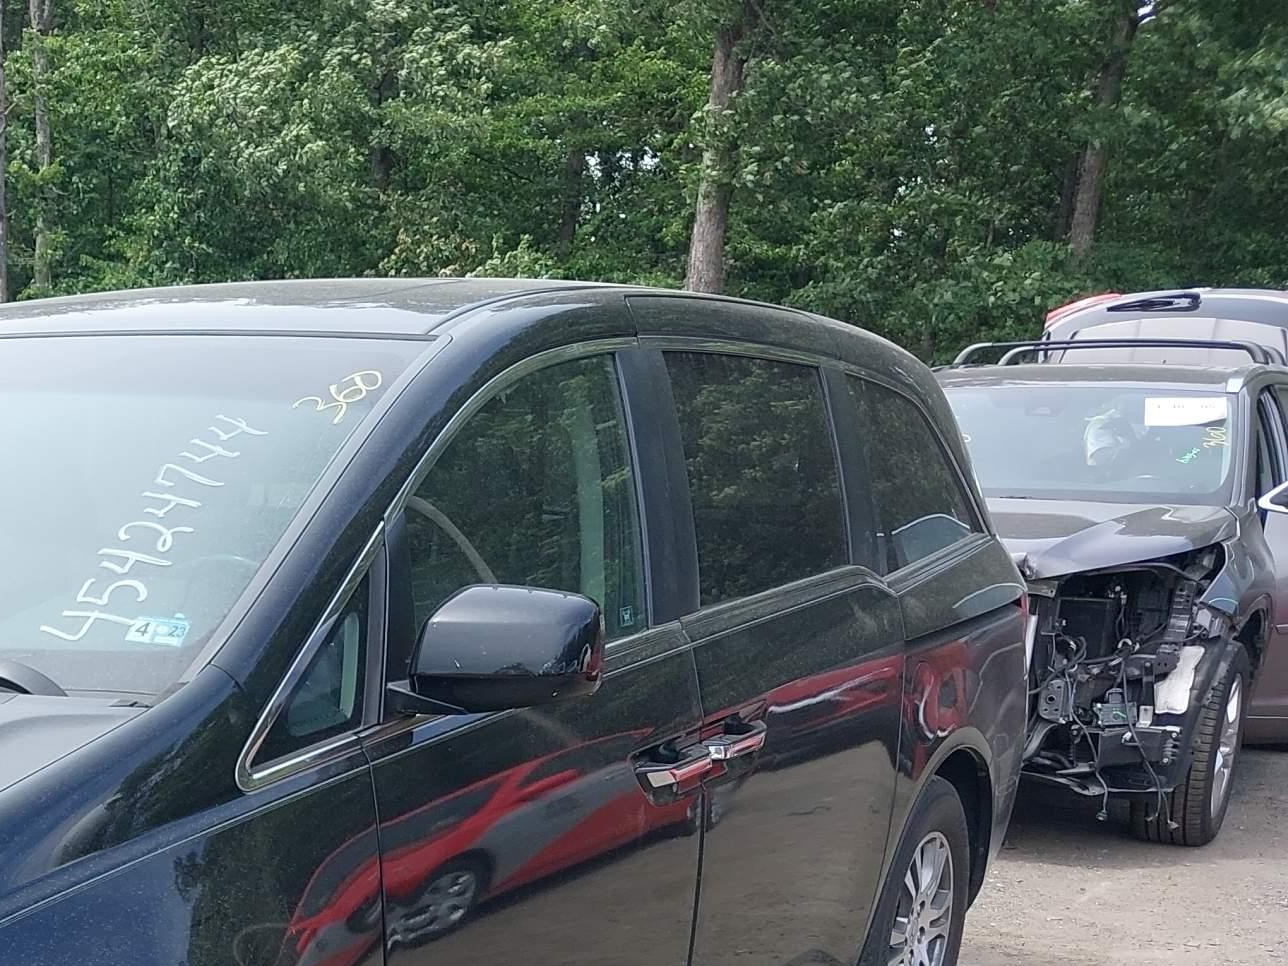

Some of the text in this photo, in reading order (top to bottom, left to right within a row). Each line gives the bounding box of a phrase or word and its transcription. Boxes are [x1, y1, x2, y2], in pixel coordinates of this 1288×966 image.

[292, 370, 382, 424] 360
[40, 414, 269, 641] 45424744
[134, 621, 152, 637] 4
